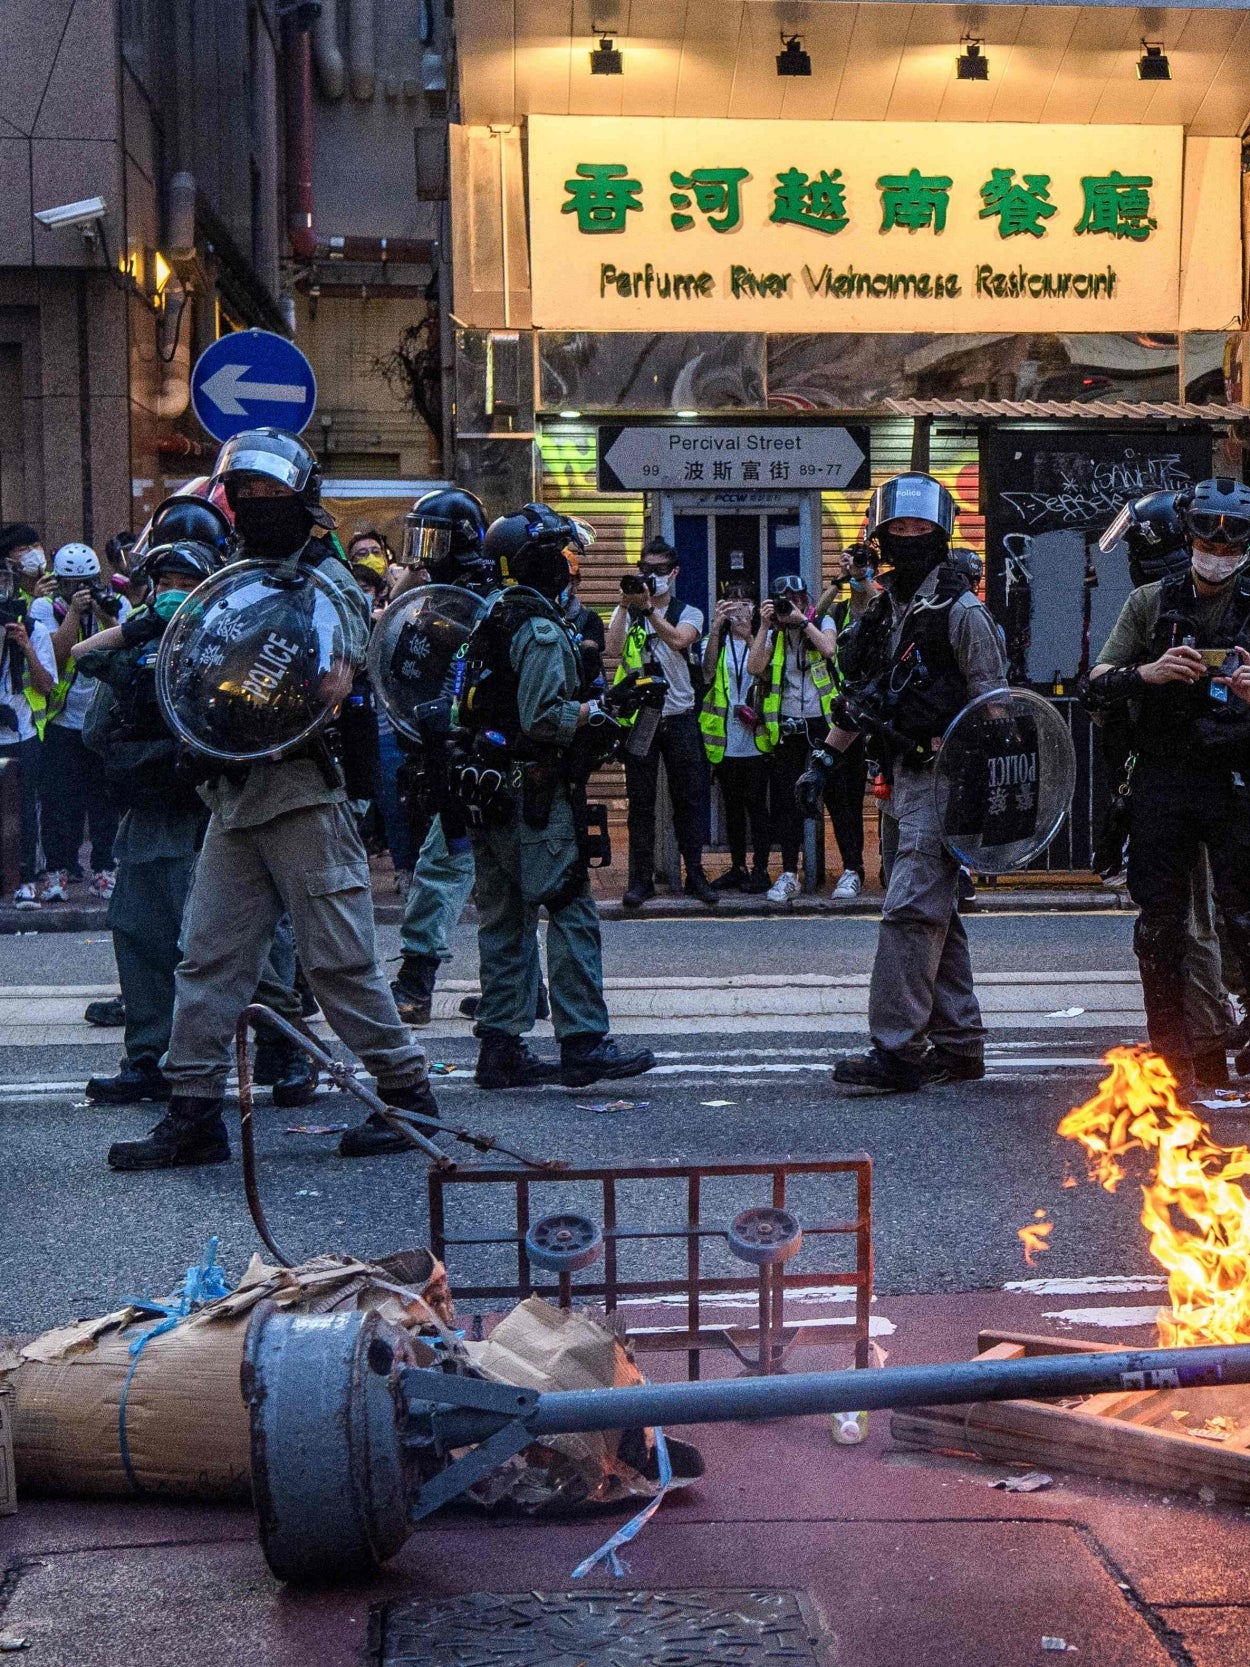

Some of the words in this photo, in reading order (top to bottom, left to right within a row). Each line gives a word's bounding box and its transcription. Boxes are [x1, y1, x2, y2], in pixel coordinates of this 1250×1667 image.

[561, 163, 1157, 240] 香河越南餐廳
[601, 263, 712, 299] Perfume
[731, 264, 790, 299] River
[805, 264, 961, 299] Vietnamese
[976, 264, 1116, 299] Restaurant
[669, 435, 740, 450] Percival
[747, 435, 801, 450] Street
[643, 465, 659, 476] 99
[684, 461, 790, 481] 波斯富街
[714, 494, 747, 502] PCCW
[897, 489, 921, 497] Police
[199, 613, 245, 674] 警察
[242, 632, 299, 701] POLICE
[988, 752, 1036, 787] POLICE
